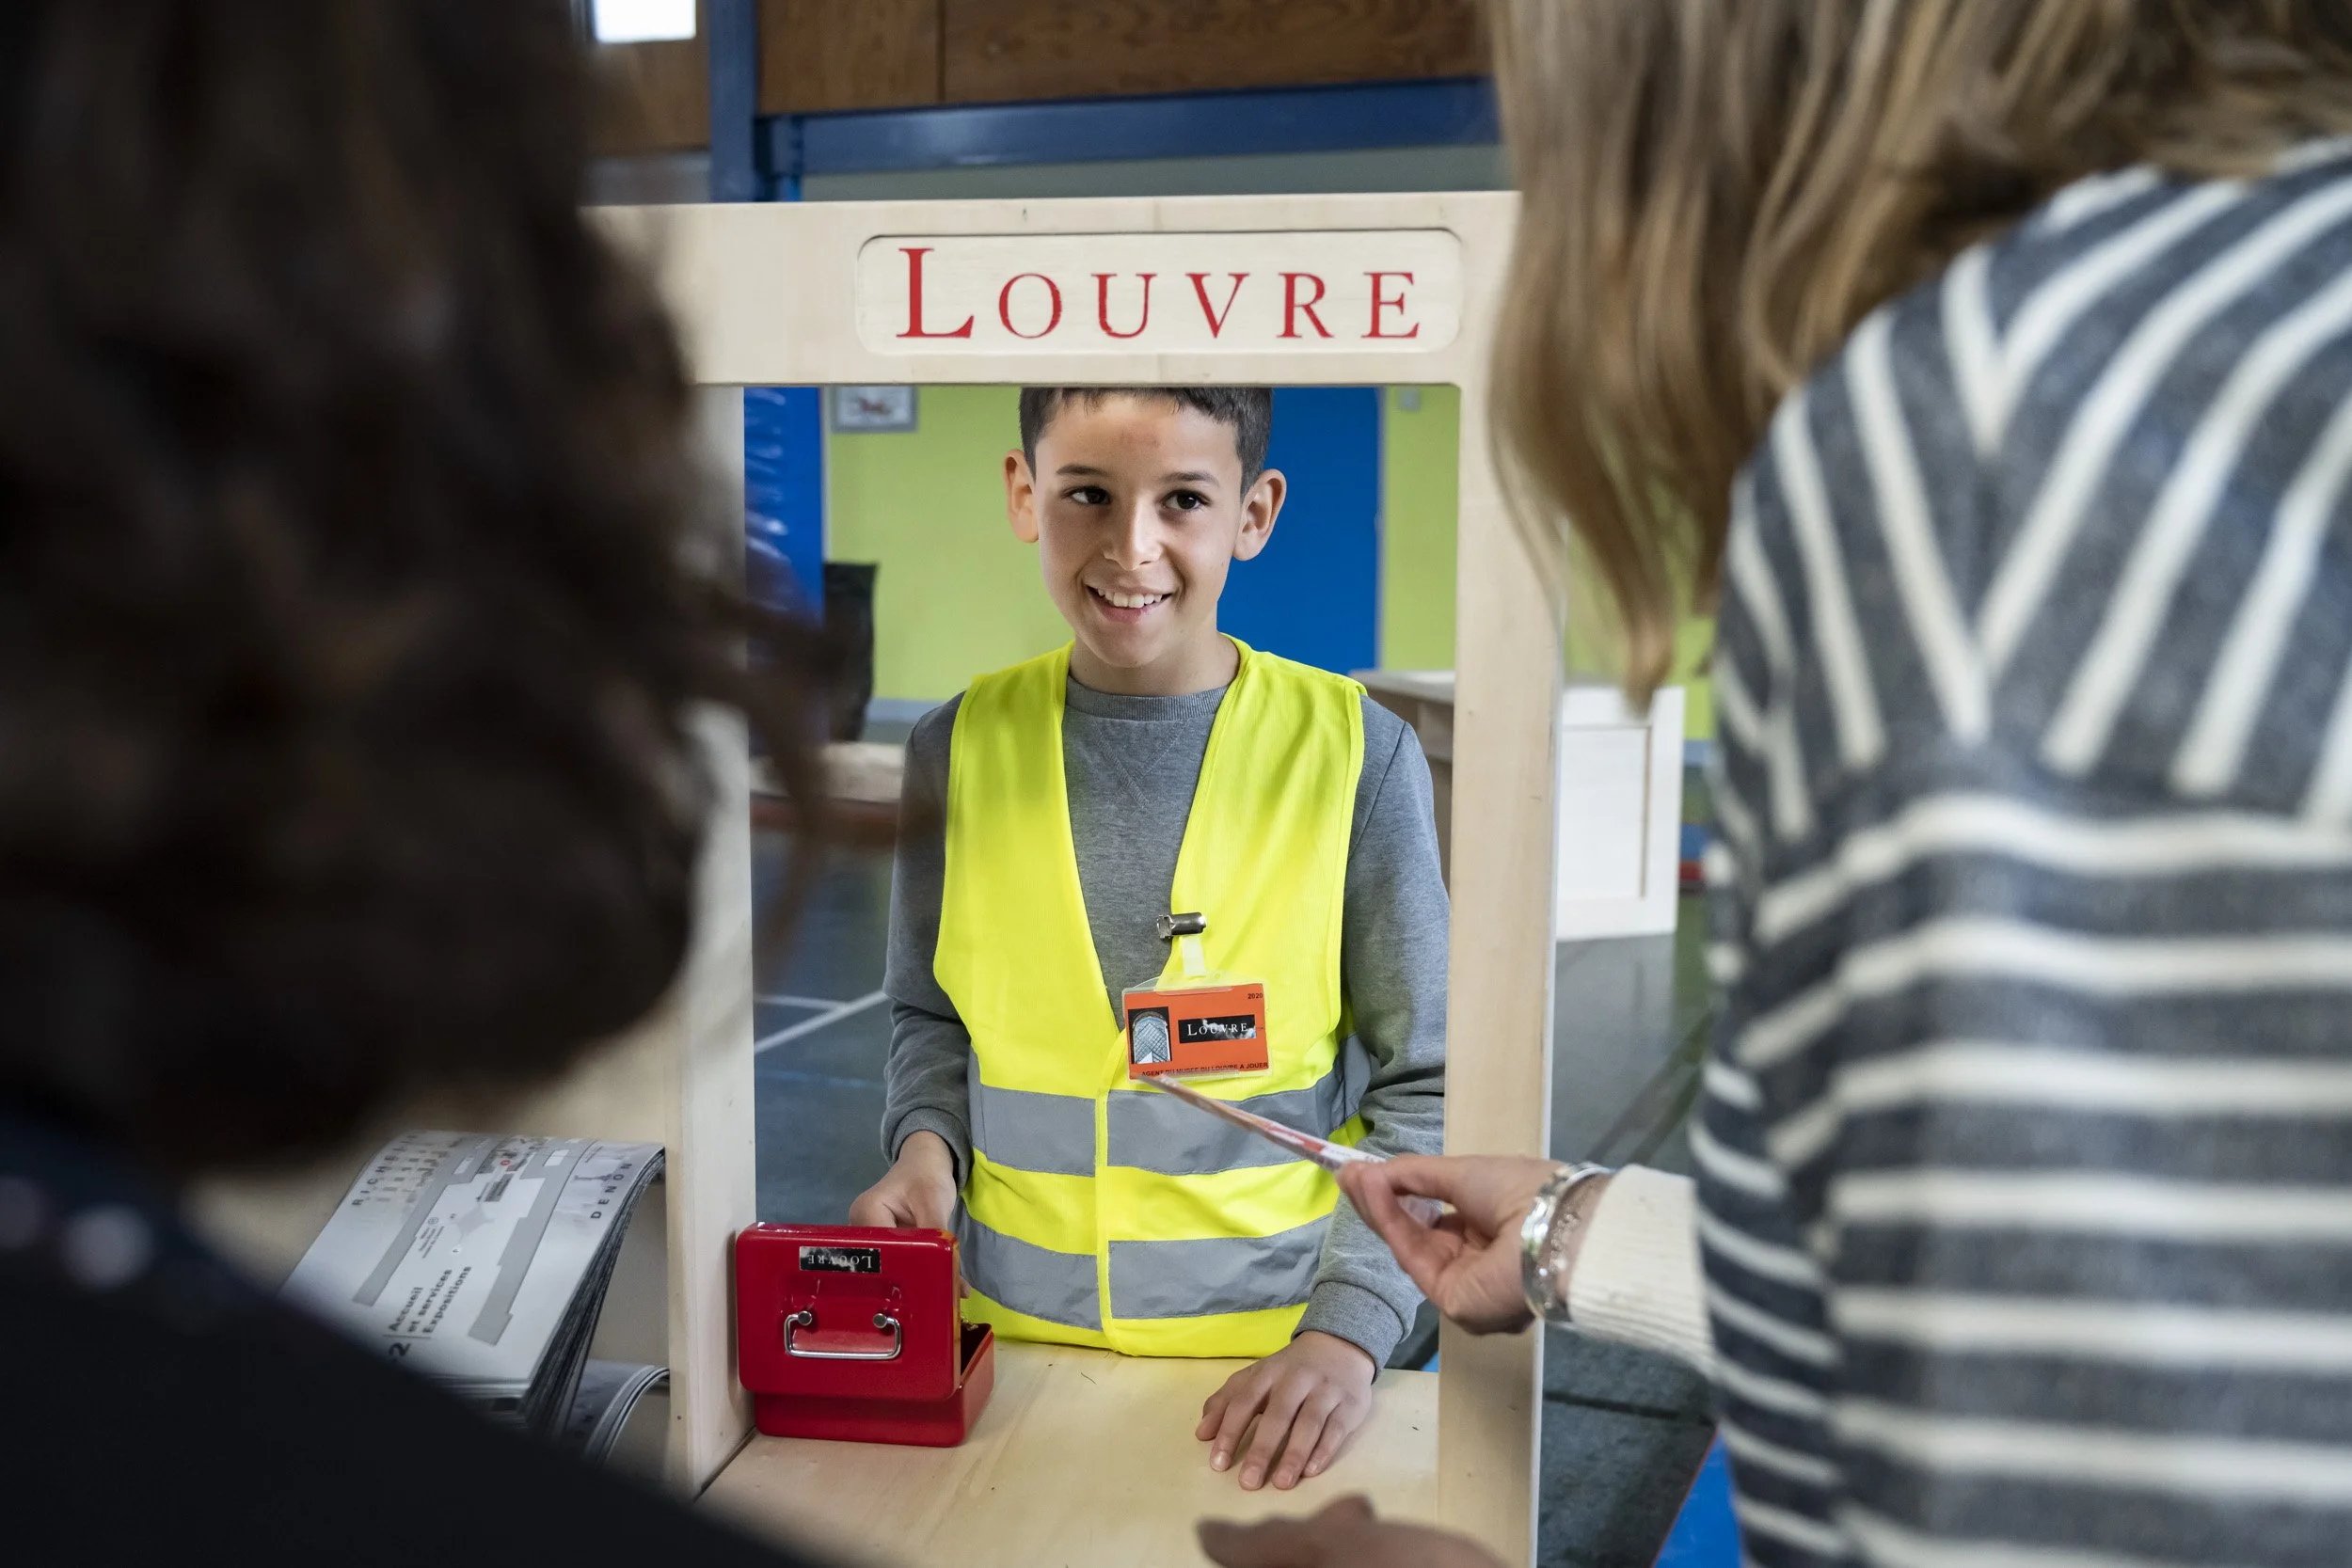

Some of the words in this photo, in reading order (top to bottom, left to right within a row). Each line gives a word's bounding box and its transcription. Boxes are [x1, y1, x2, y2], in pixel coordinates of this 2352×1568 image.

[896, 246, 1421, 340] LOUVRE
[1187, 1022, 1248, 1037] LOUVRE
[590, 1163, 633, 1220] DENON
[807, 1254, 873, 1269] LOUVRE
[389, 1287, 423, 1332] Accueil
[407, 1321, 421, 1333] et
[418, 1269, 453, 1316] services
[422, 1266, 471, 1333] Expositions
